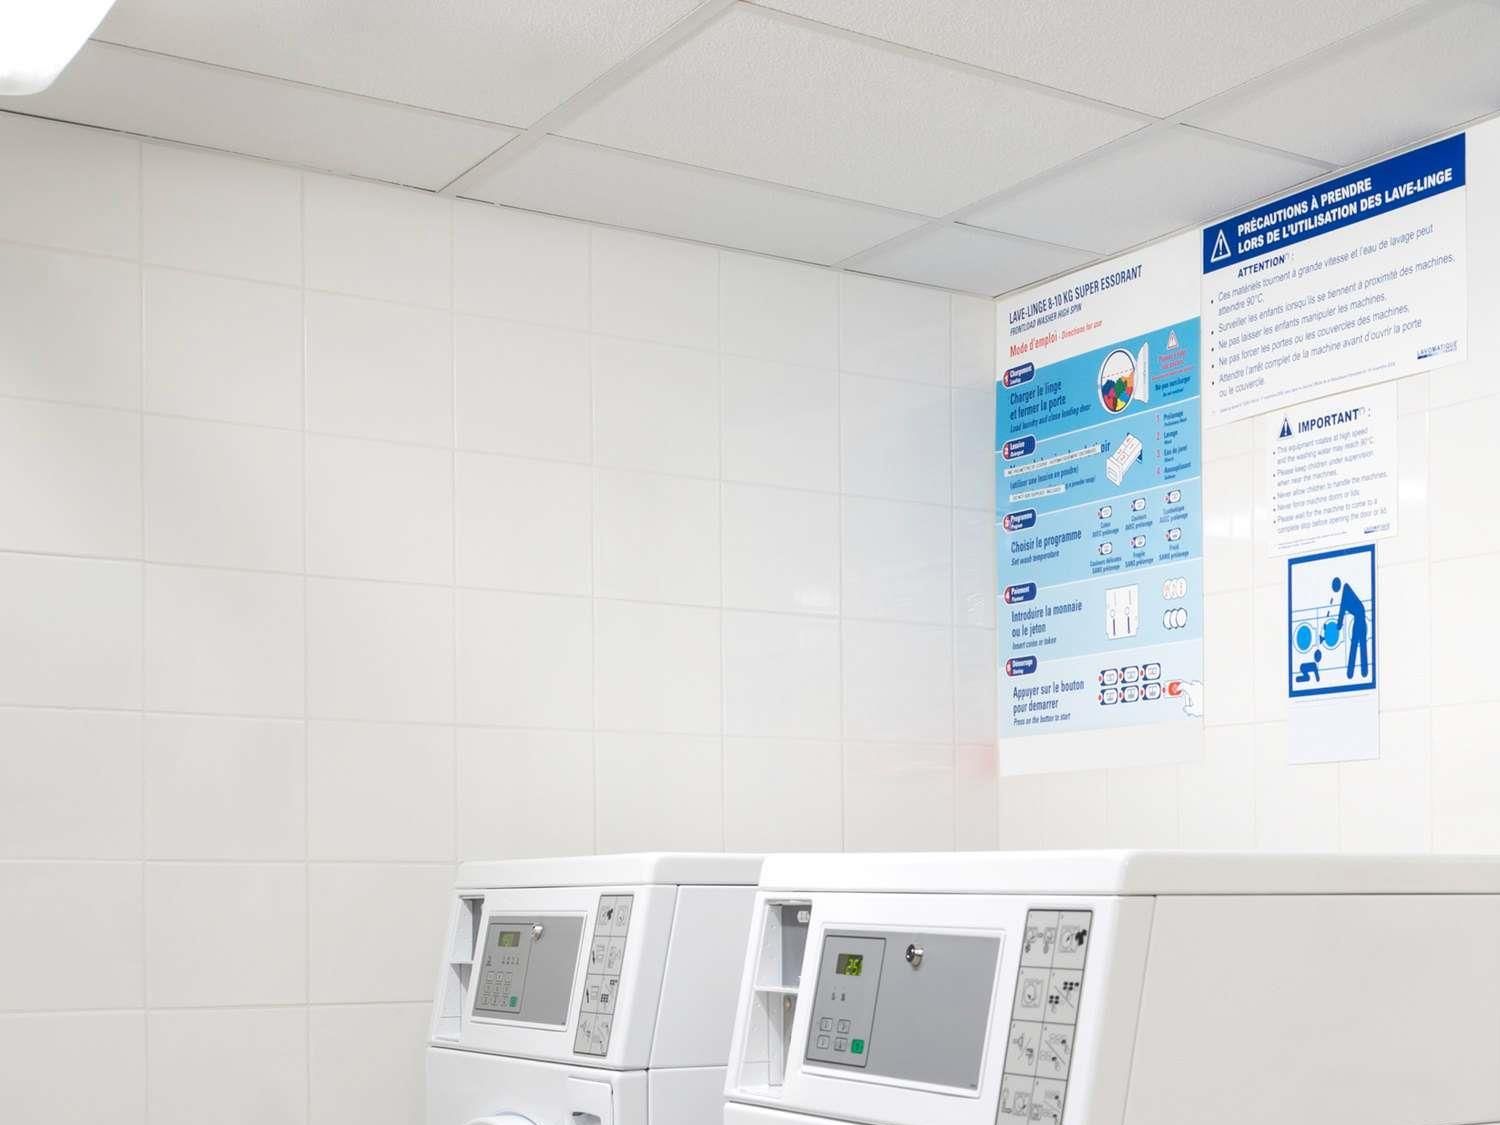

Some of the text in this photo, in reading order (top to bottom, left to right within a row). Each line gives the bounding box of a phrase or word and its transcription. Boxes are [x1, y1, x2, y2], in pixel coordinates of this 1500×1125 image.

[1238, 178, 1372, 236] PRÉCAUTIONS À PRENDRE
[1238, 168, 1453, 253] LORS DE L'UTILISATION DES LAVE-LINGE
[1010, 265, 1142, 324] LAVE-LINGE 8-10 KG SUPER ESSORANT
[1010, 382, 1061, 405] Charger le linge
[1010, 395, 1066, 420] et fermer la porte
[1011, 530, 1081, 553] Choisir le programme
[1012, 600, 1082, 622] Introduire la monnaie
[1012, 624, 1046, 637] ou le jeton
[1013, 680, 1084, 700] Appuyer sur le bouton
